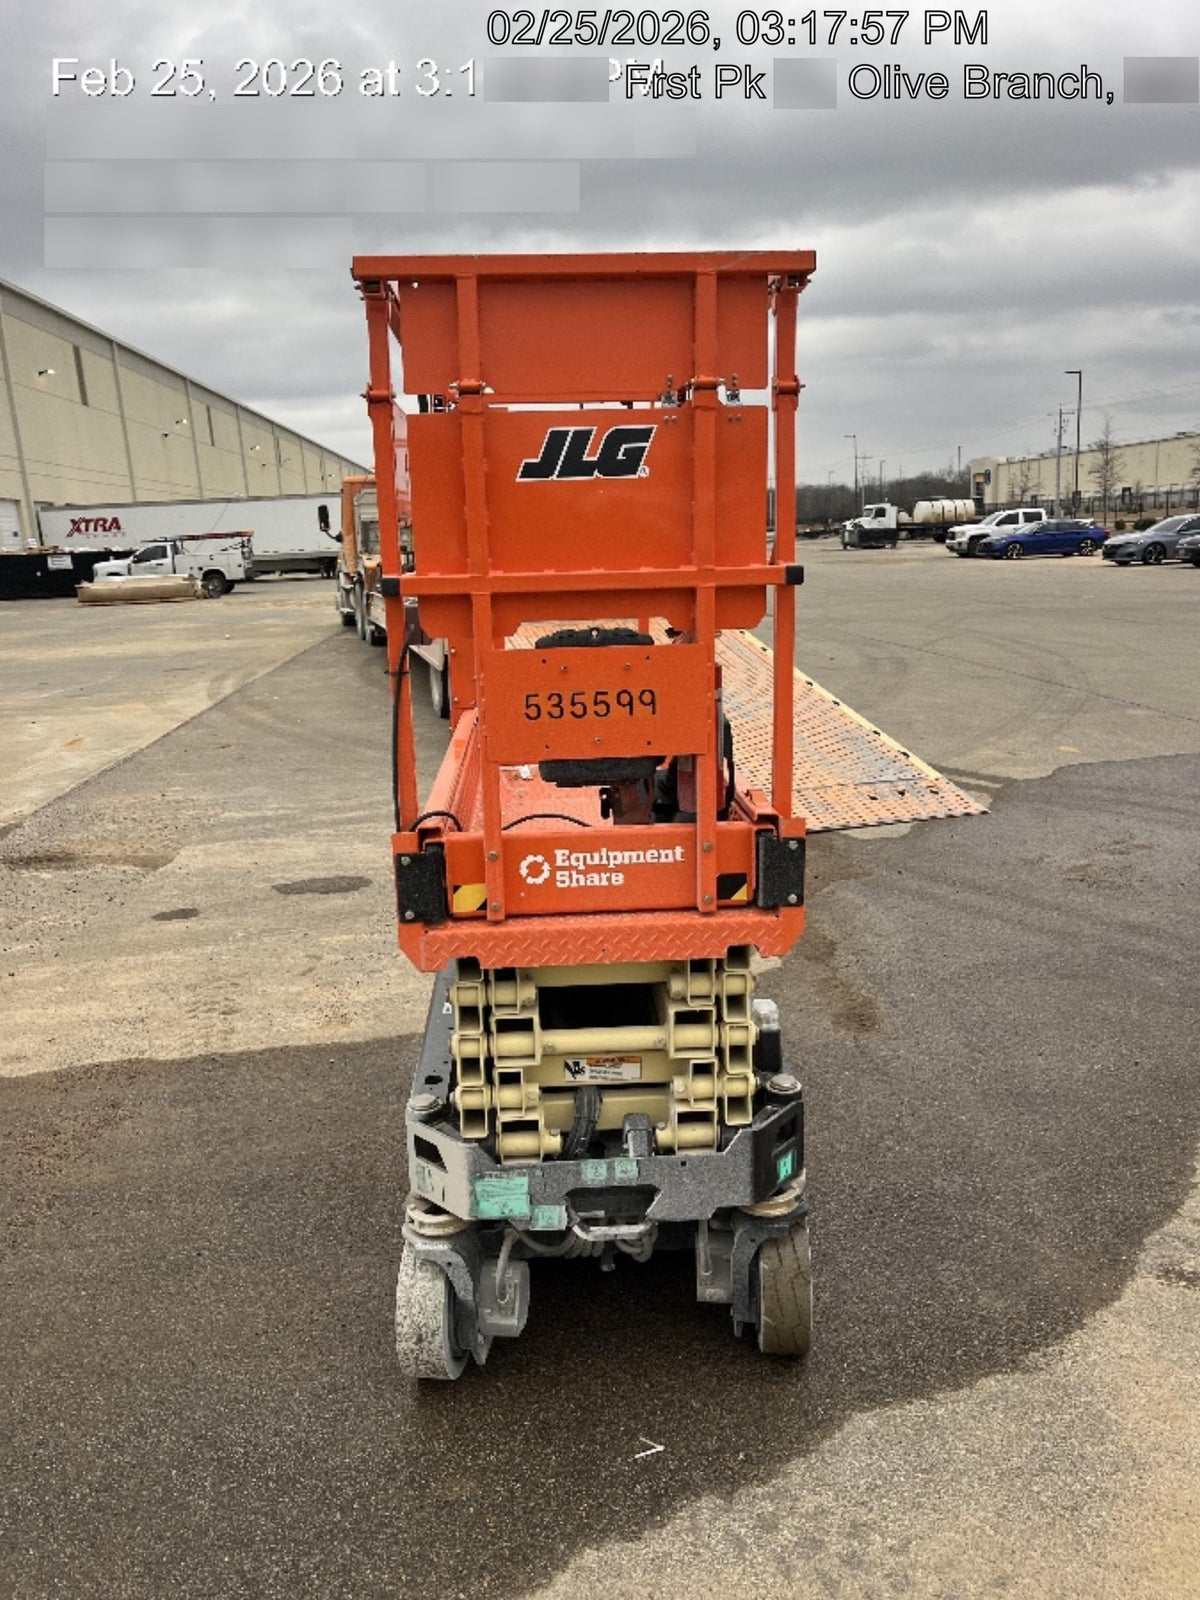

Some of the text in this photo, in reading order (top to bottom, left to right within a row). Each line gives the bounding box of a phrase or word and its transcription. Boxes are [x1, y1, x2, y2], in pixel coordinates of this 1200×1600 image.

[515, 424, 658, 482] JLG
[66, 517, 121, 538] XTRA
[524, 689, 656, 720] 535599
[554, 845, 685, 870] Equipment
[556, 870, 625, 888] Share
